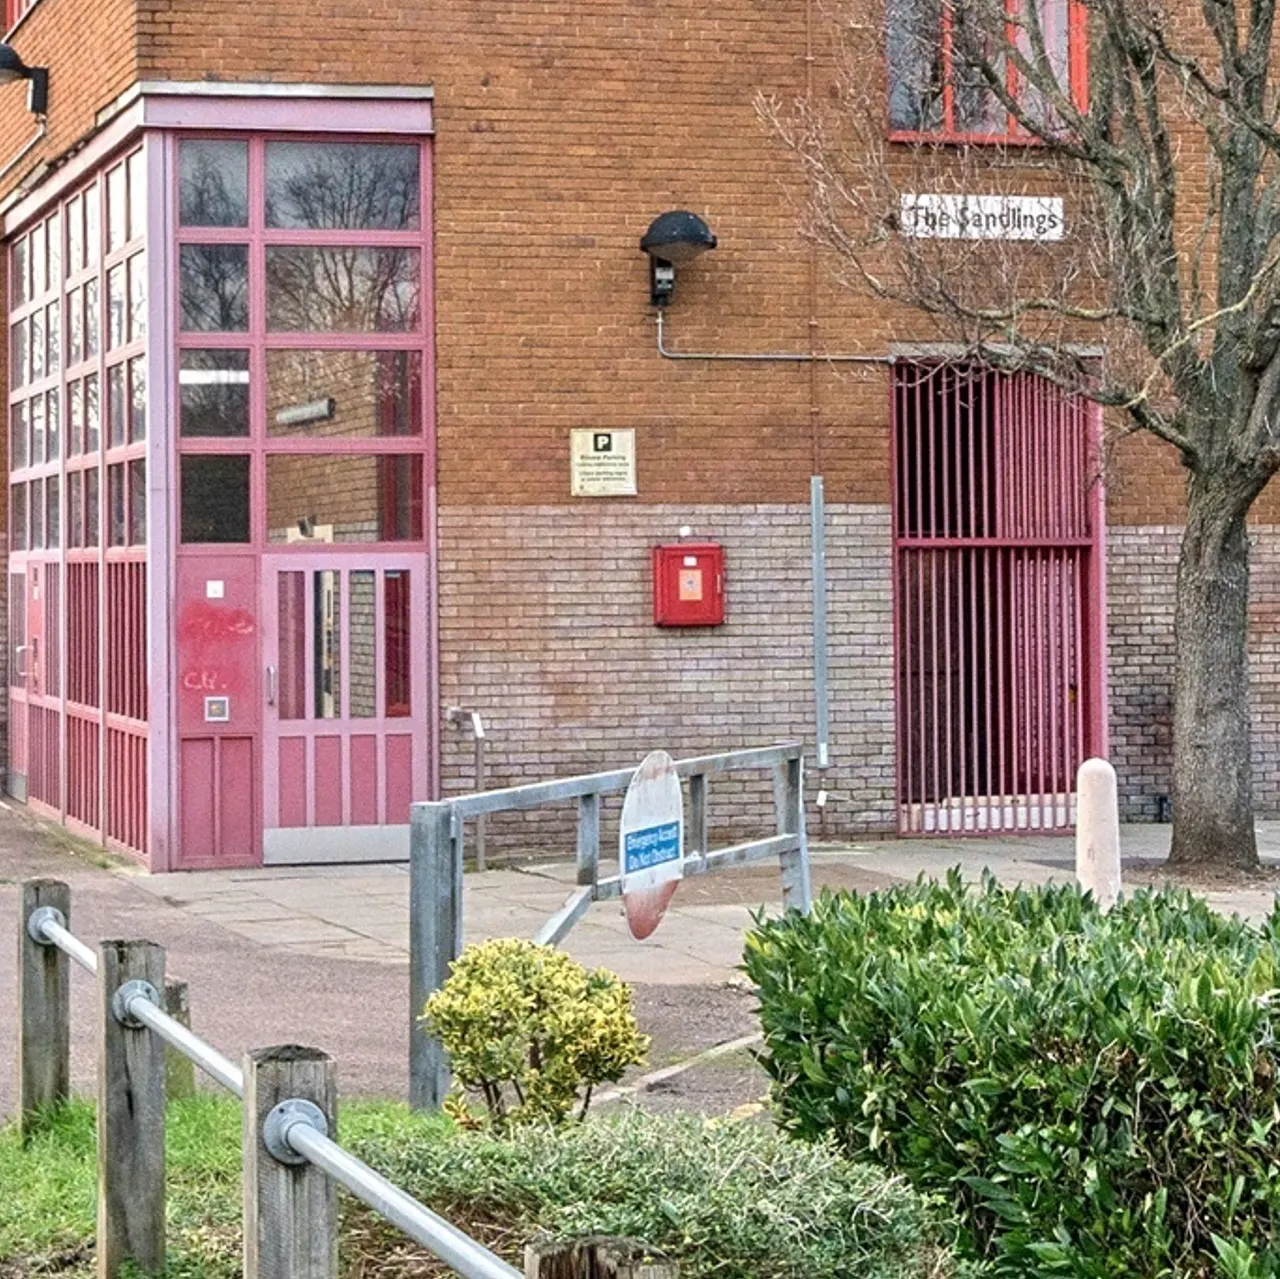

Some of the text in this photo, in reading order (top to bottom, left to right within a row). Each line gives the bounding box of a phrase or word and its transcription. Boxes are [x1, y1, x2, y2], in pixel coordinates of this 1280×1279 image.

[909, 206, 1058, 235] The Sandlings
[597, 435, 609, 450] P
